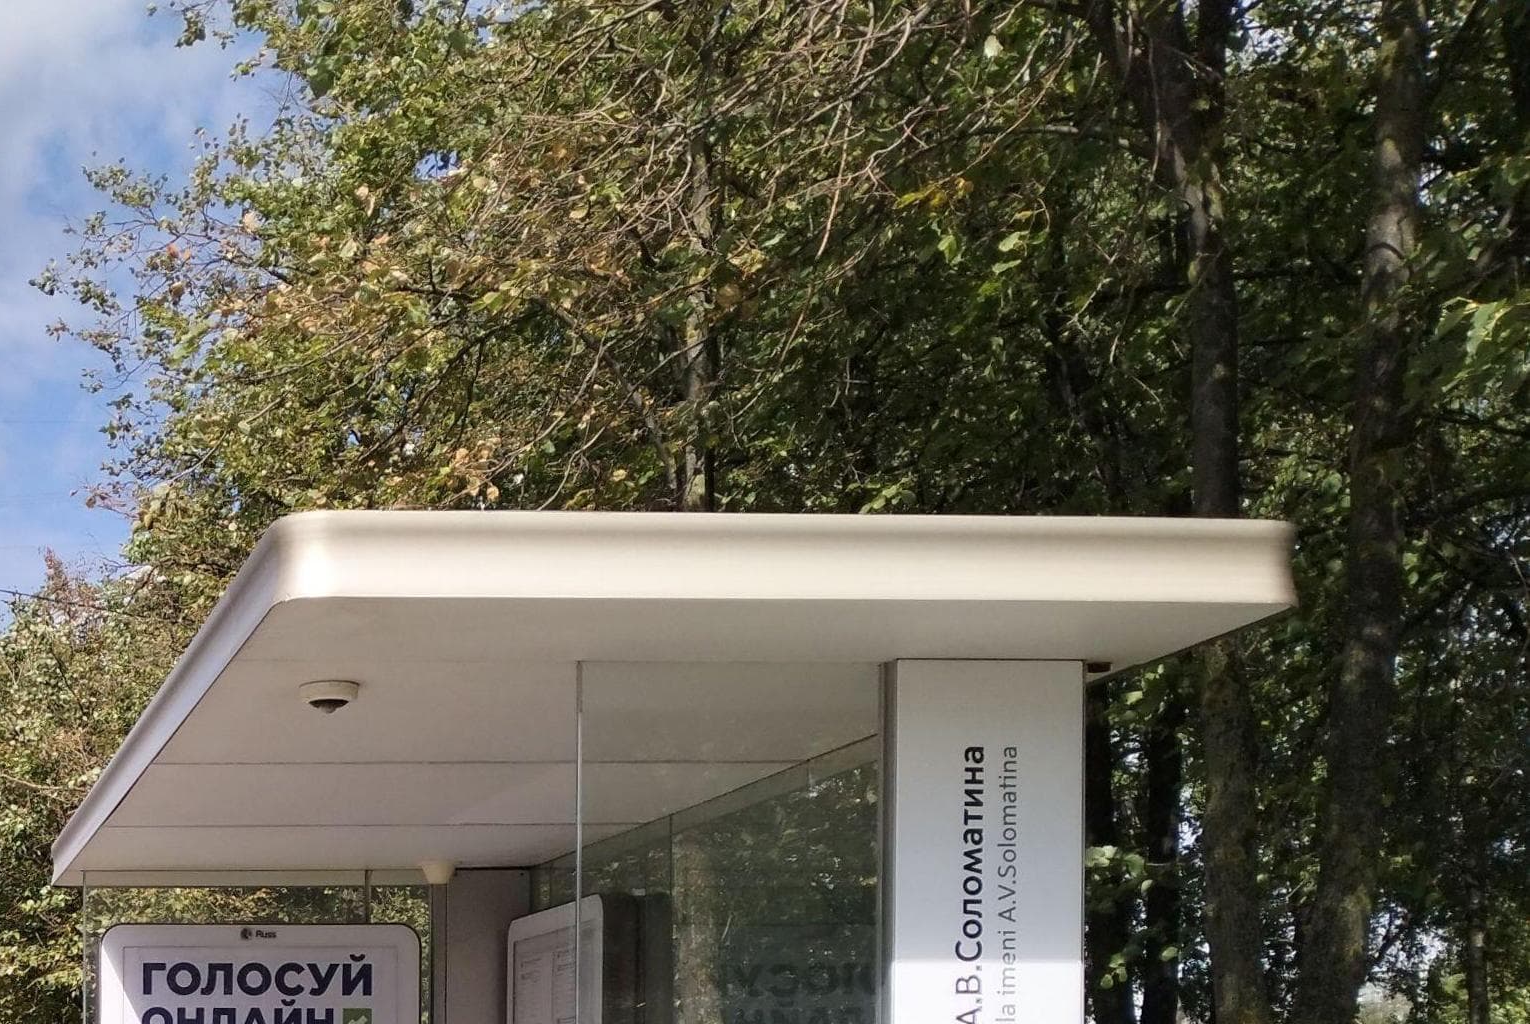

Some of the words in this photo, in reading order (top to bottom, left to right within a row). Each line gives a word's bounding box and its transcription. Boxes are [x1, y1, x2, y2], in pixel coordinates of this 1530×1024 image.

[998, 745, 1018, 922] A.V.Solomatina
[142, 953, 372, 997] ГОЛОСУЙ
[997, 930, 1017, 996] imeni
